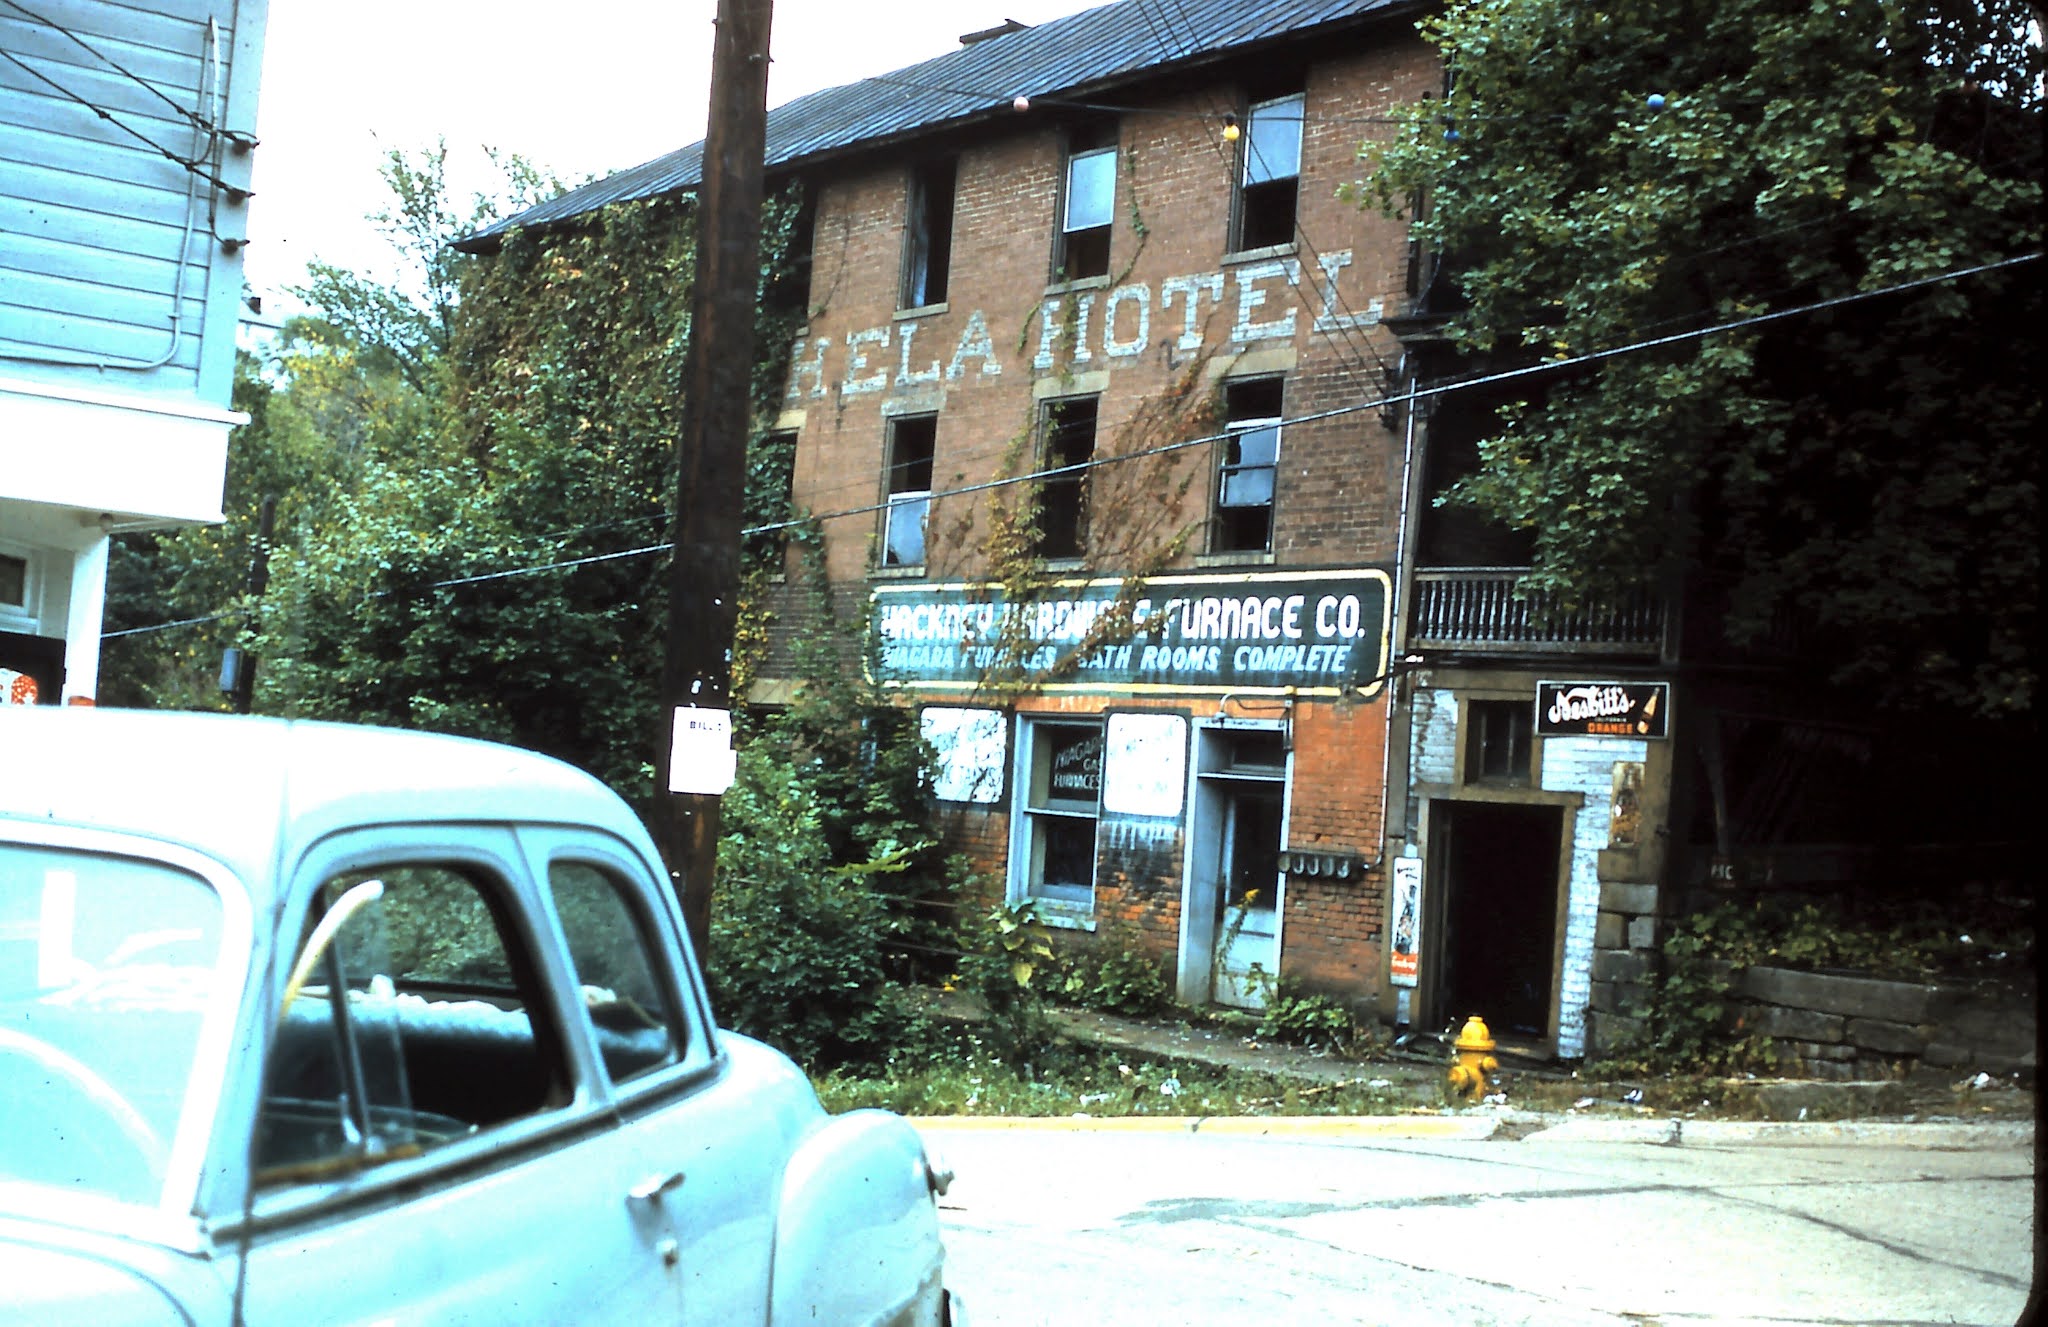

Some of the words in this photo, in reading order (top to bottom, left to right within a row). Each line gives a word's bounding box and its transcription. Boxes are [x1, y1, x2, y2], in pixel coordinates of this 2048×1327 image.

[1034, 249, 1382, 368] HOTEL
[881, 603, 993, 640] HACKNEY
[1162, 595, 1304, 639] FURNACE
[1316, 594, 1366, 639] CO.
[881, 645, 954, 669] NIAGARA
[1141, 645, 1221, 671] ROOMS
[1234, 645, 1351, 672] COMPLETE
[1588, 722, 1633, 734] ORANGE
[1055, 735, 1103, 770] NIAGAR
